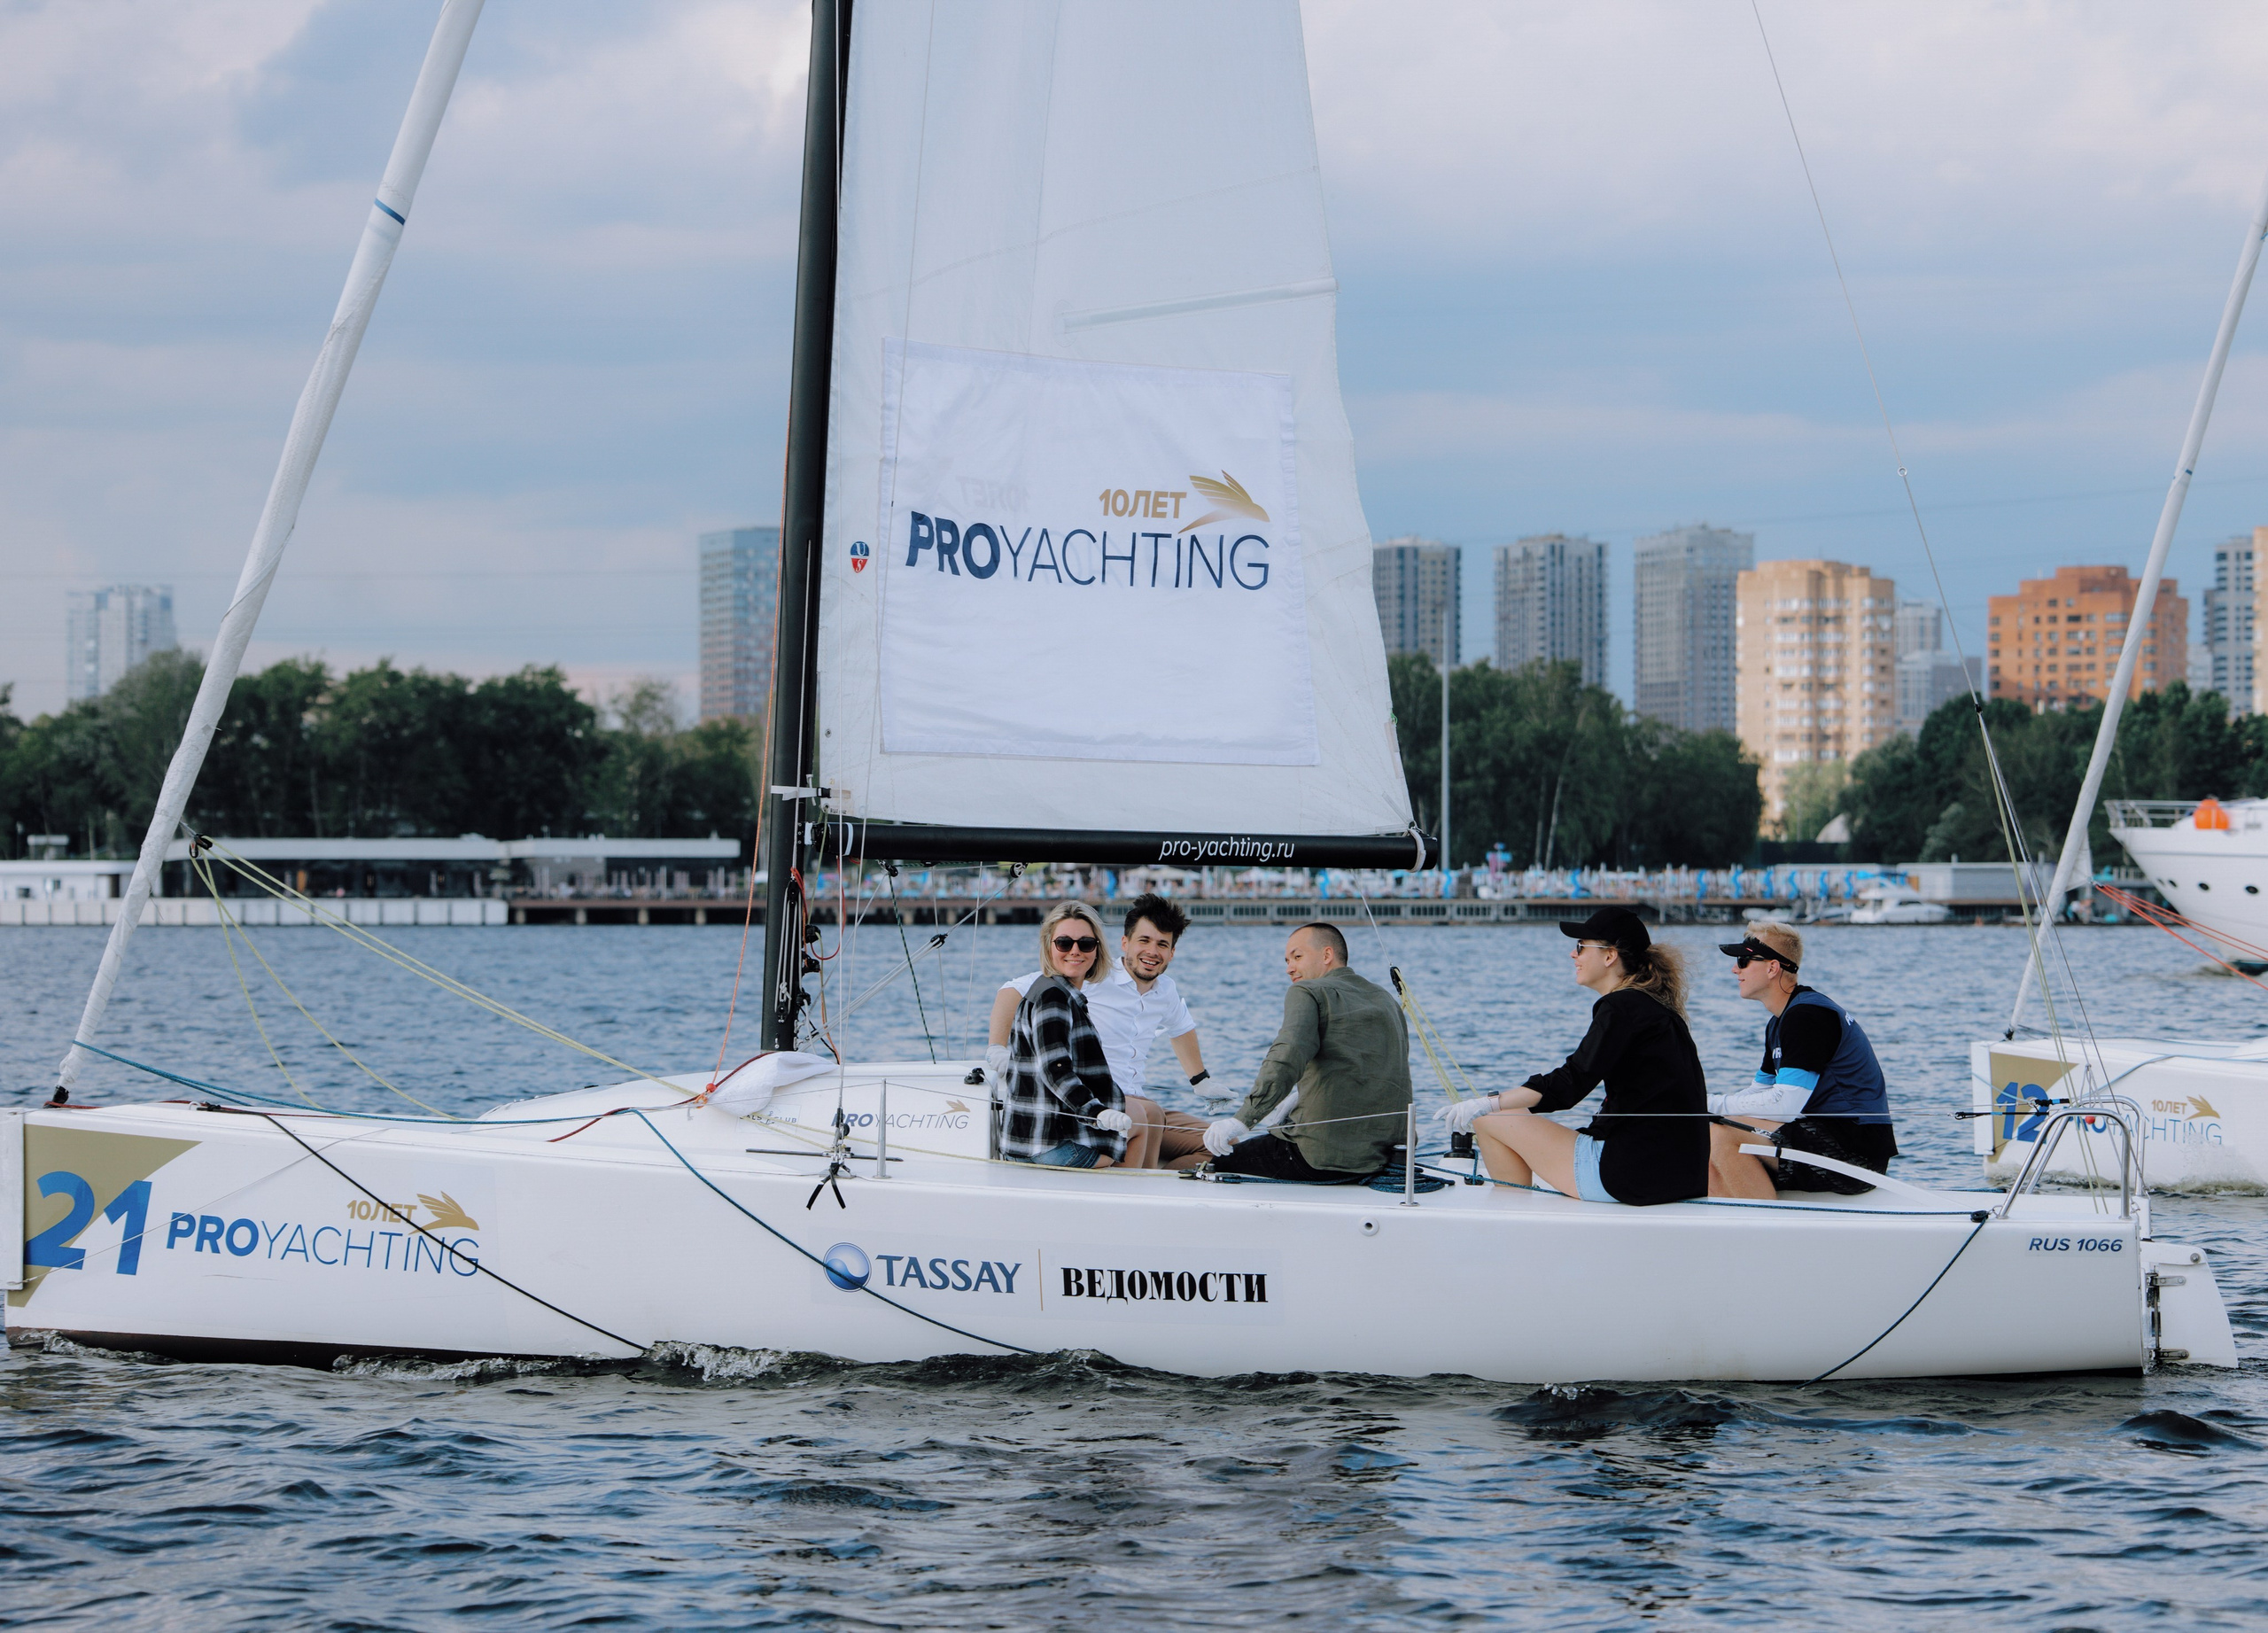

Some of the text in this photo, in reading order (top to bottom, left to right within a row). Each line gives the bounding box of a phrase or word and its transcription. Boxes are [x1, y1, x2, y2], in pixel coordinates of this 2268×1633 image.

[905, 510, 1270, 591] PROYACHTING
[1158, 836, 1295, 862] pro-yachting.ru
[1996, 1082, 2048, 1145] 12
[2063, 1107, 2222, 1146] OYACHTING
[24, 1170, 153, 1276] 21
[167, 1211, 479, 1277] PROYACHTING
[2029, 1237, 2123, 1252] RUS 1066
[875, 1254, 1022, 1294] TASSAY
[1060, 1267, 1269, 1305] ВЕДОМОСТИ
